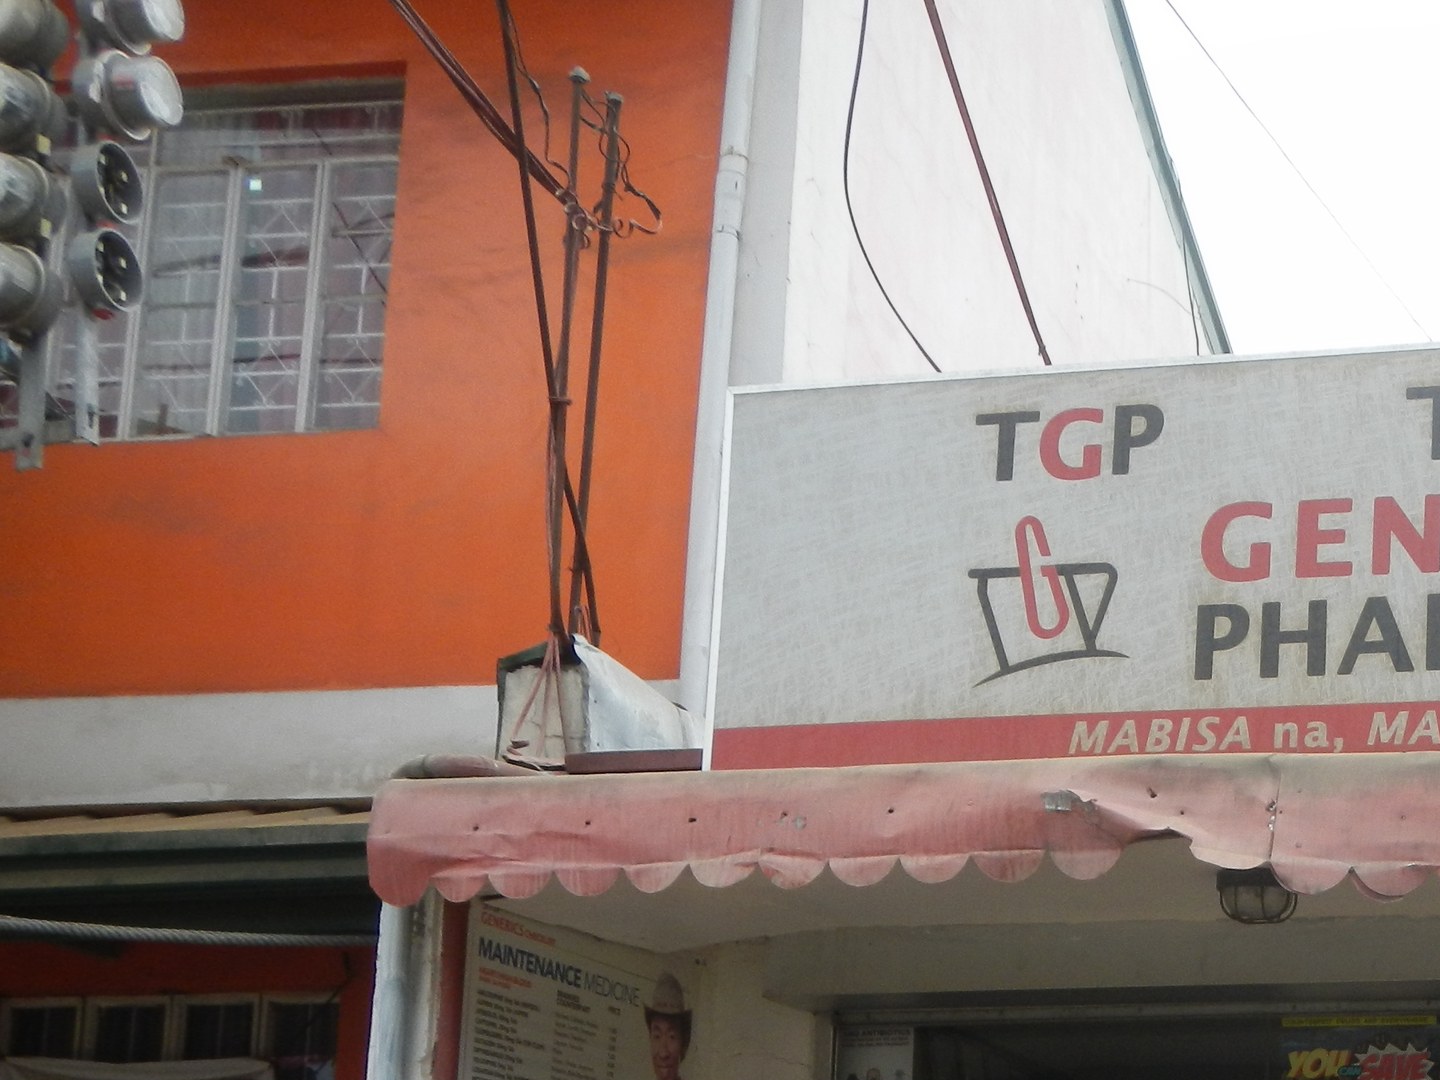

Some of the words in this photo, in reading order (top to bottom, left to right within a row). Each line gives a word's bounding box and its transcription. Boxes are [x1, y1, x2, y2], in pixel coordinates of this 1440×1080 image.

[976, 404, 1164, 481] TGP
[1068, 715, 1252, 755] MABISA
[1273, 718, 1345, 754] na,
[479, 937, 582, 988] MAINTENANCE
[584, 972, 640, 1007] MEDICINE
[1287, 1048, 1352, 1079] YOU
